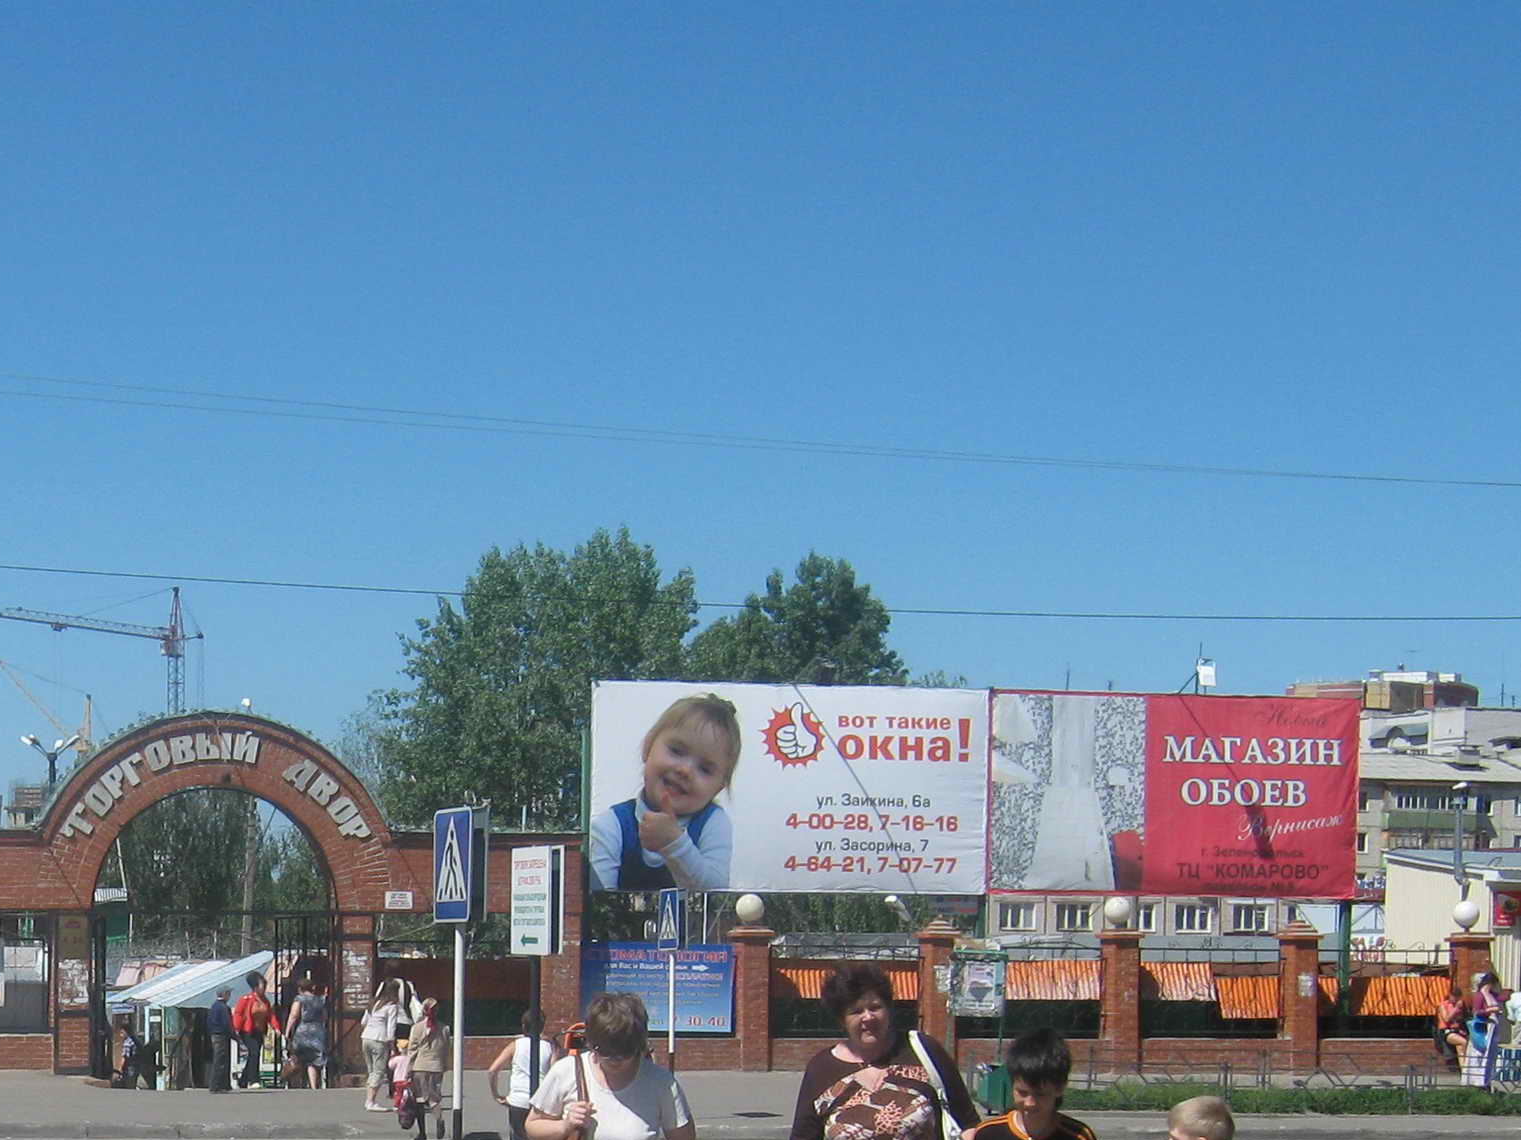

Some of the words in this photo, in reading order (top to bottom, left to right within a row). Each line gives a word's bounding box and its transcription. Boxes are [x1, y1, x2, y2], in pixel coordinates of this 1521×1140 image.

[838, 714, 876, 728] вот
[887, 715, 951, 729] такие
[837, 718, 971, 762] окна!
[1162, 735, 1344, 766] МАГАЗИН
[59, 731, 261, 840] ТОРГОВЫЙ
[282, 759, 372, 840] ДВОР
[1181, 778, 1308, 808] ОБОЕВ
[816, 796, 837, 809] ул.
[912, 794, 931, 807] 6а
[785, 813, 874, 832] 4-00-28,
[879, 814, 958, 832] 7-16-16
[815, 841, 836, 854] ул.
[840, 838, 915, 854] Засорина,
[920, 839, 929, 851] 7
[1215, 847, 1304, 858] Зеленольск
[784, 856, 872, 875] 4-64-21,
[877, 857, 957, 874] 7-07-77
[1176, 863, 1200, 880] ТЦ
